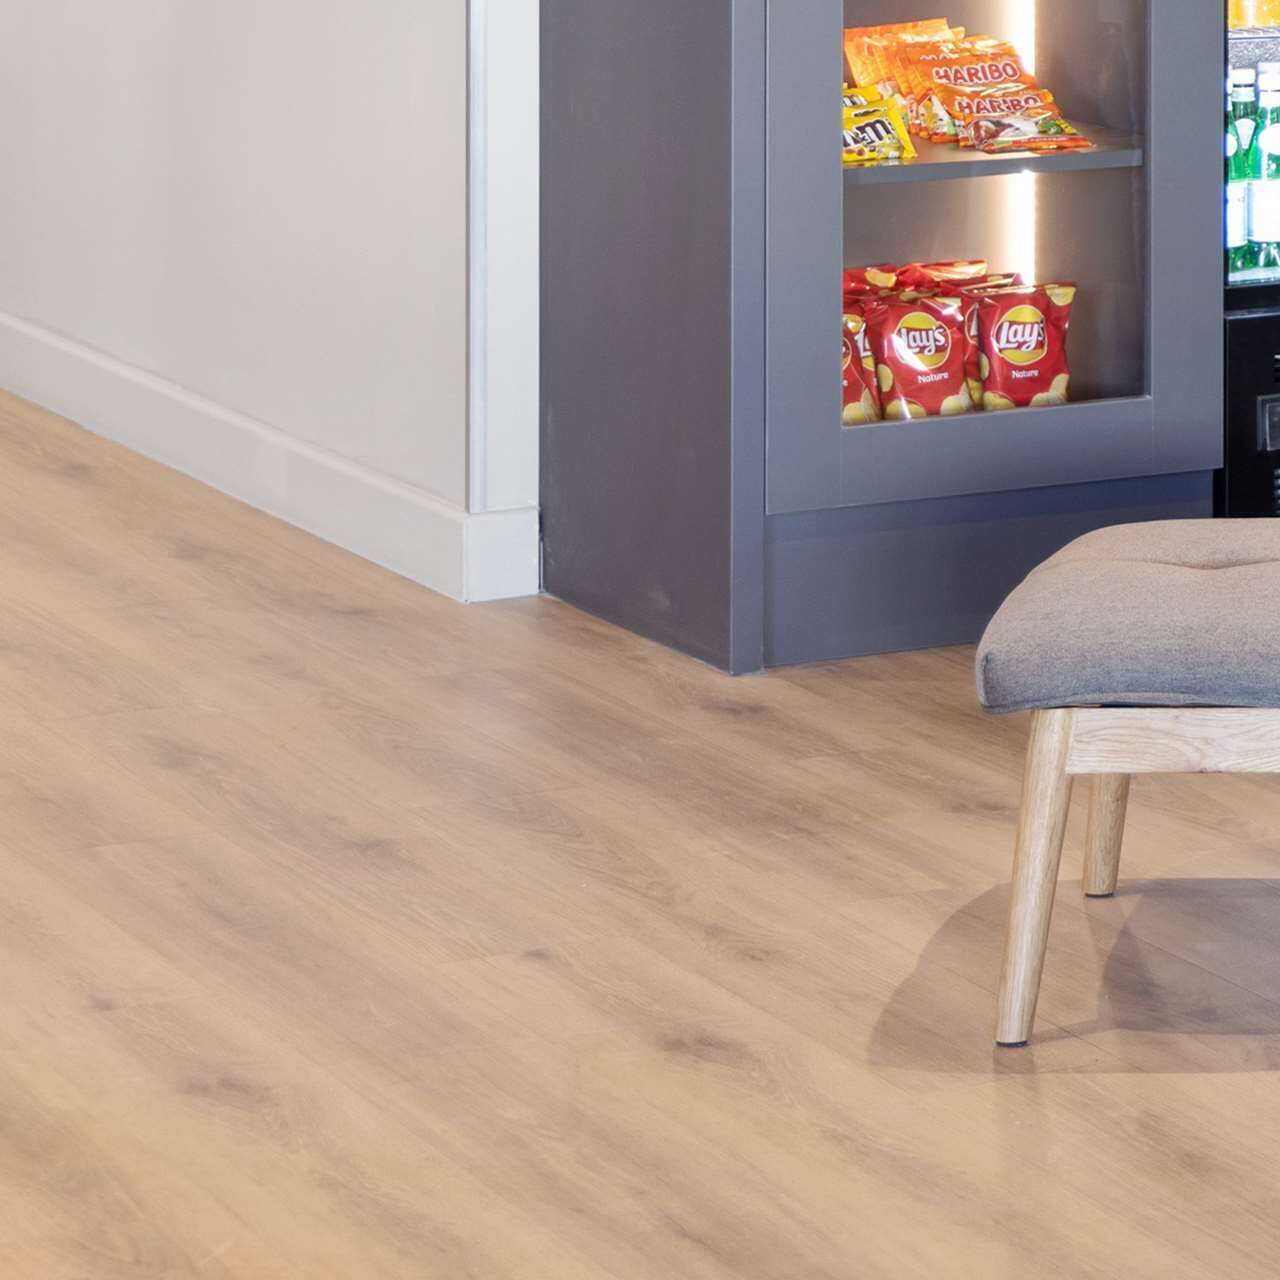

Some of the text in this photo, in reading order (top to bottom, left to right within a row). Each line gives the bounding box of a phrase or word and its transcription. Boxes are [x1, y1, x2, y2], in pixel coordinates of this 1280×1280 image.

[933, 61, 1020, 84] HARIBO
[954, 94, 1042, 115] HARIBO
[917, 371, 948, 384] Nature
[1012, 370, 1039, 379] Nature
